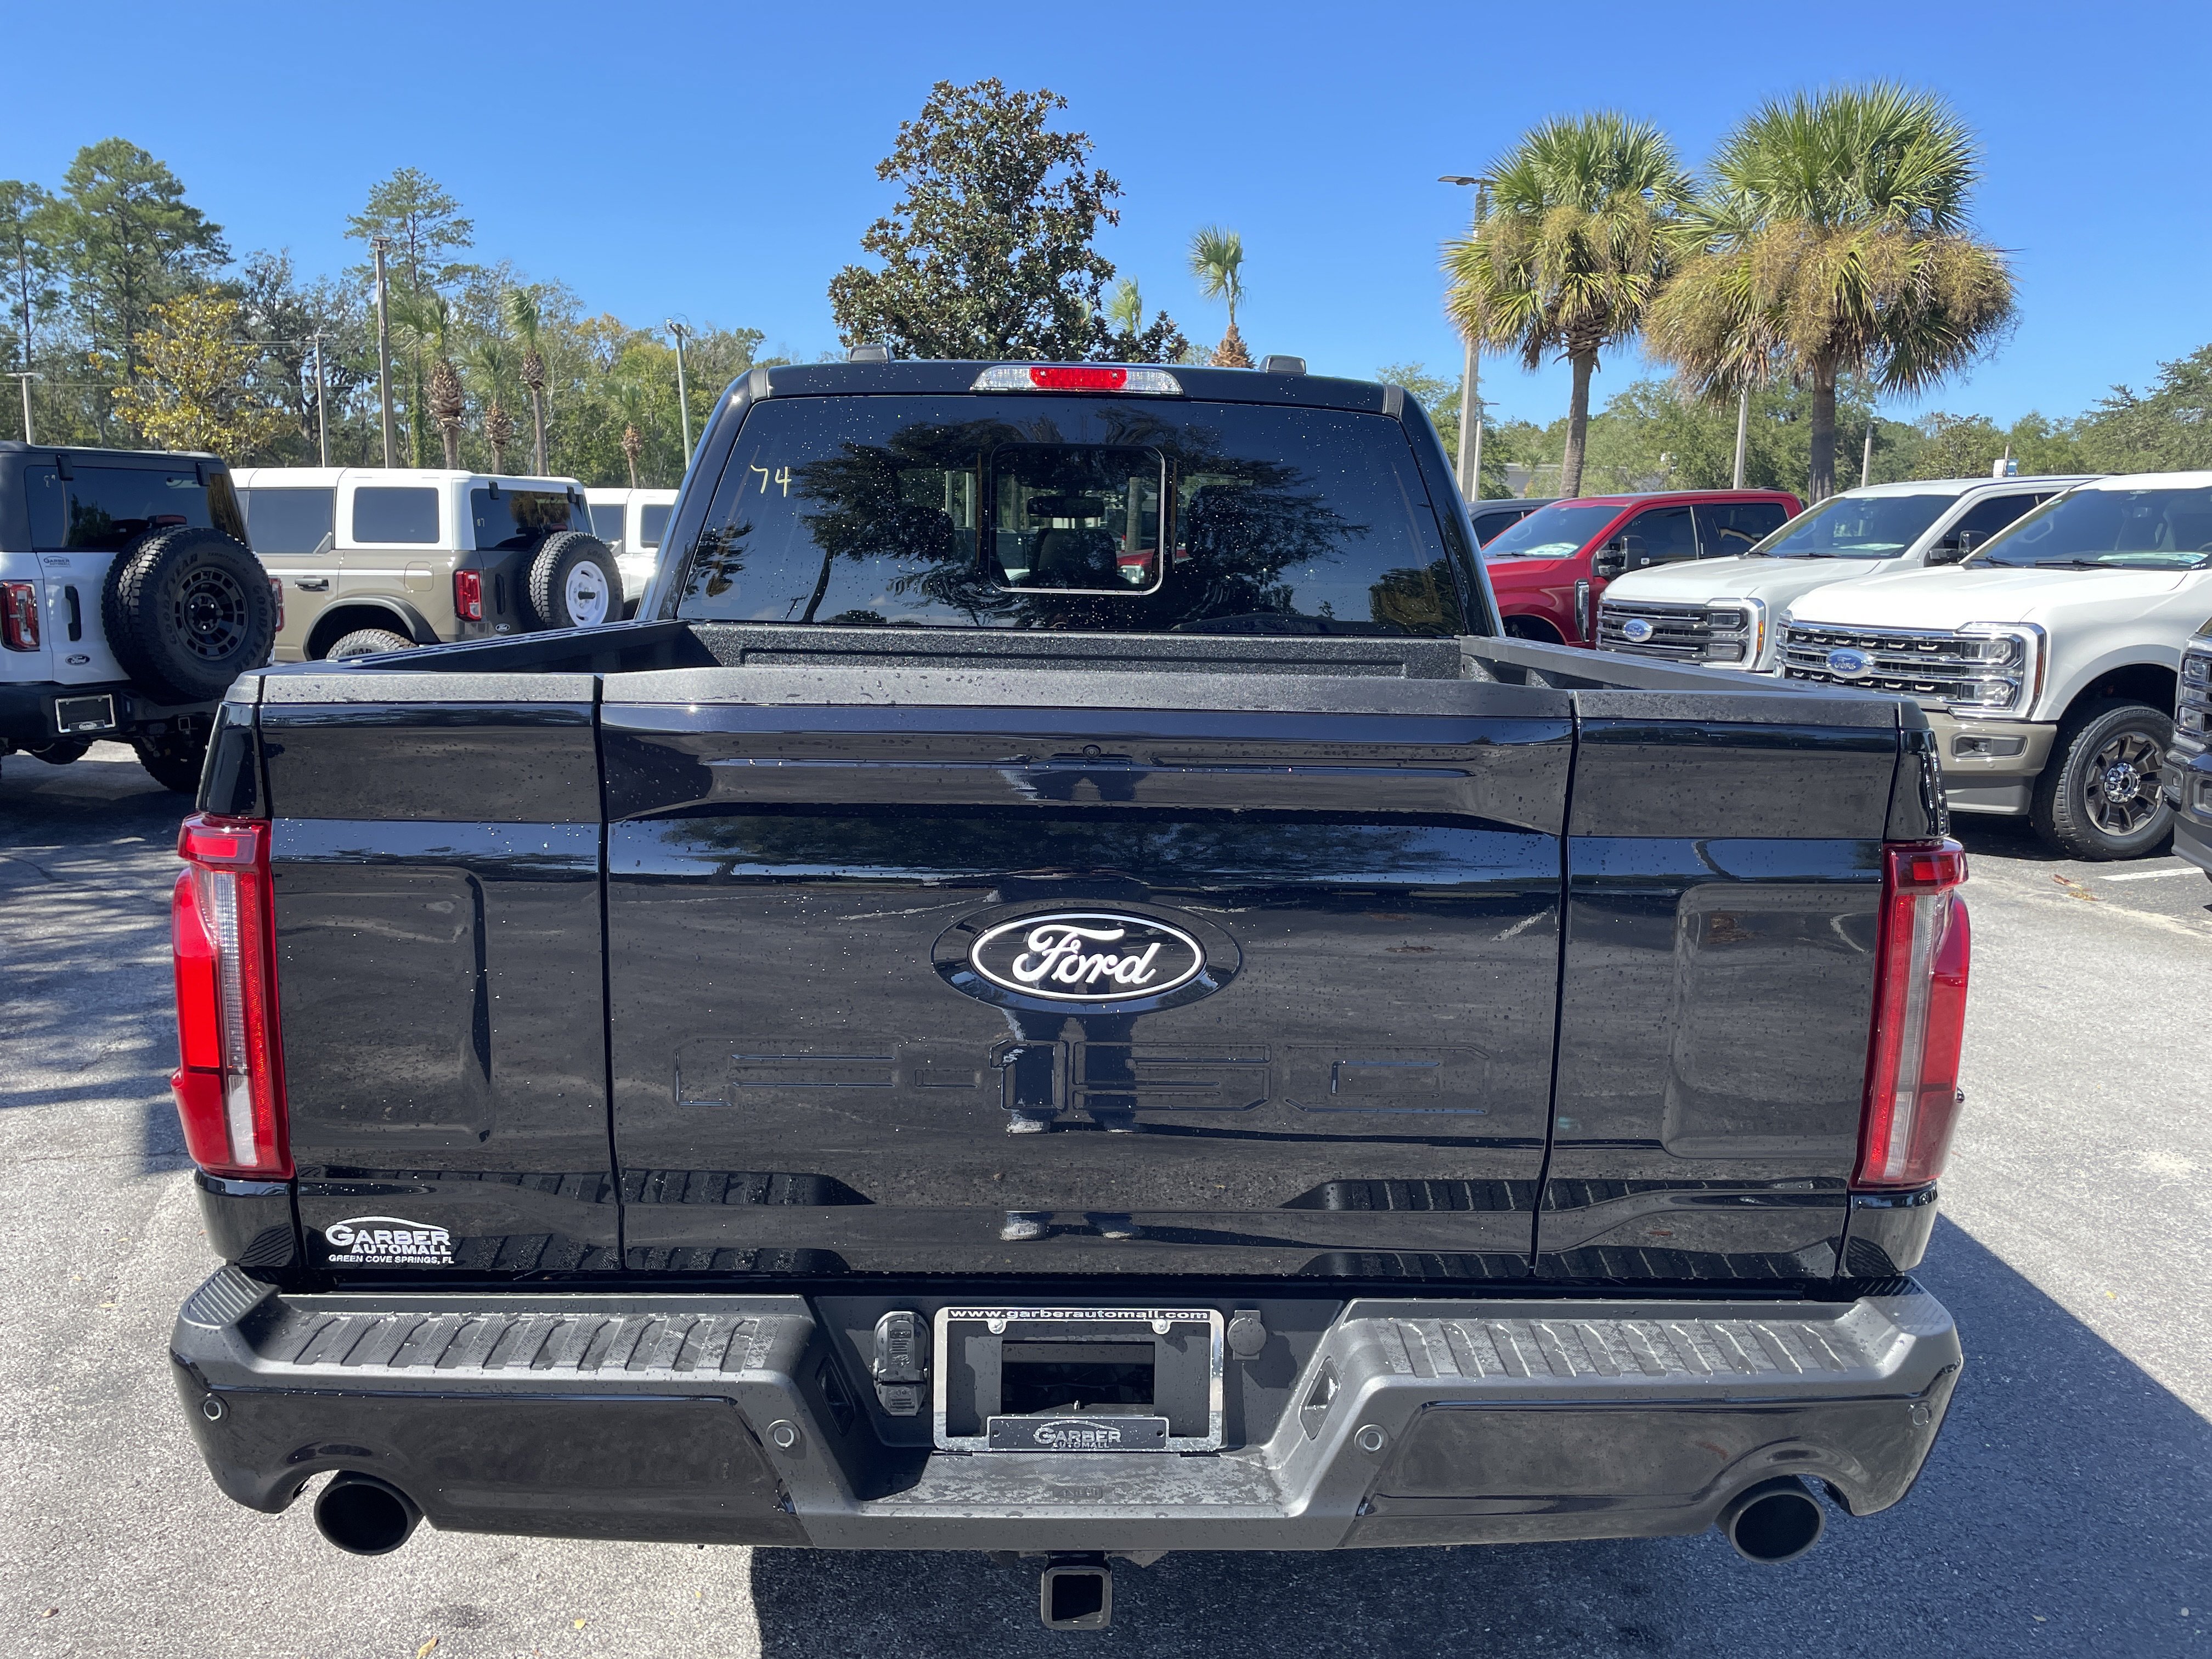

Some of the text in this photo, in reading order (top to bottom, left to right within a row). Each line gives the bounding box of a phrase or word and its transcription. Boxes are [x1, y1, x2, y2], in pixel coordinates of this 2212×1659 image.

[750, 465, 792, 498] 74
[1012, 924, 1160, 984] Ford
[325, 1224, 451, 1246] GARBER
[351, 1244, 452, 1255] AUTOMALL
[329, 1254, 363, 1262] GREEN
[394, 1256, 441, 1265] SPRINGS,
[950, 1308, 1208, 1320] www.garberautomall.com
[1034, 1427, 1122, 1444] GARBER
